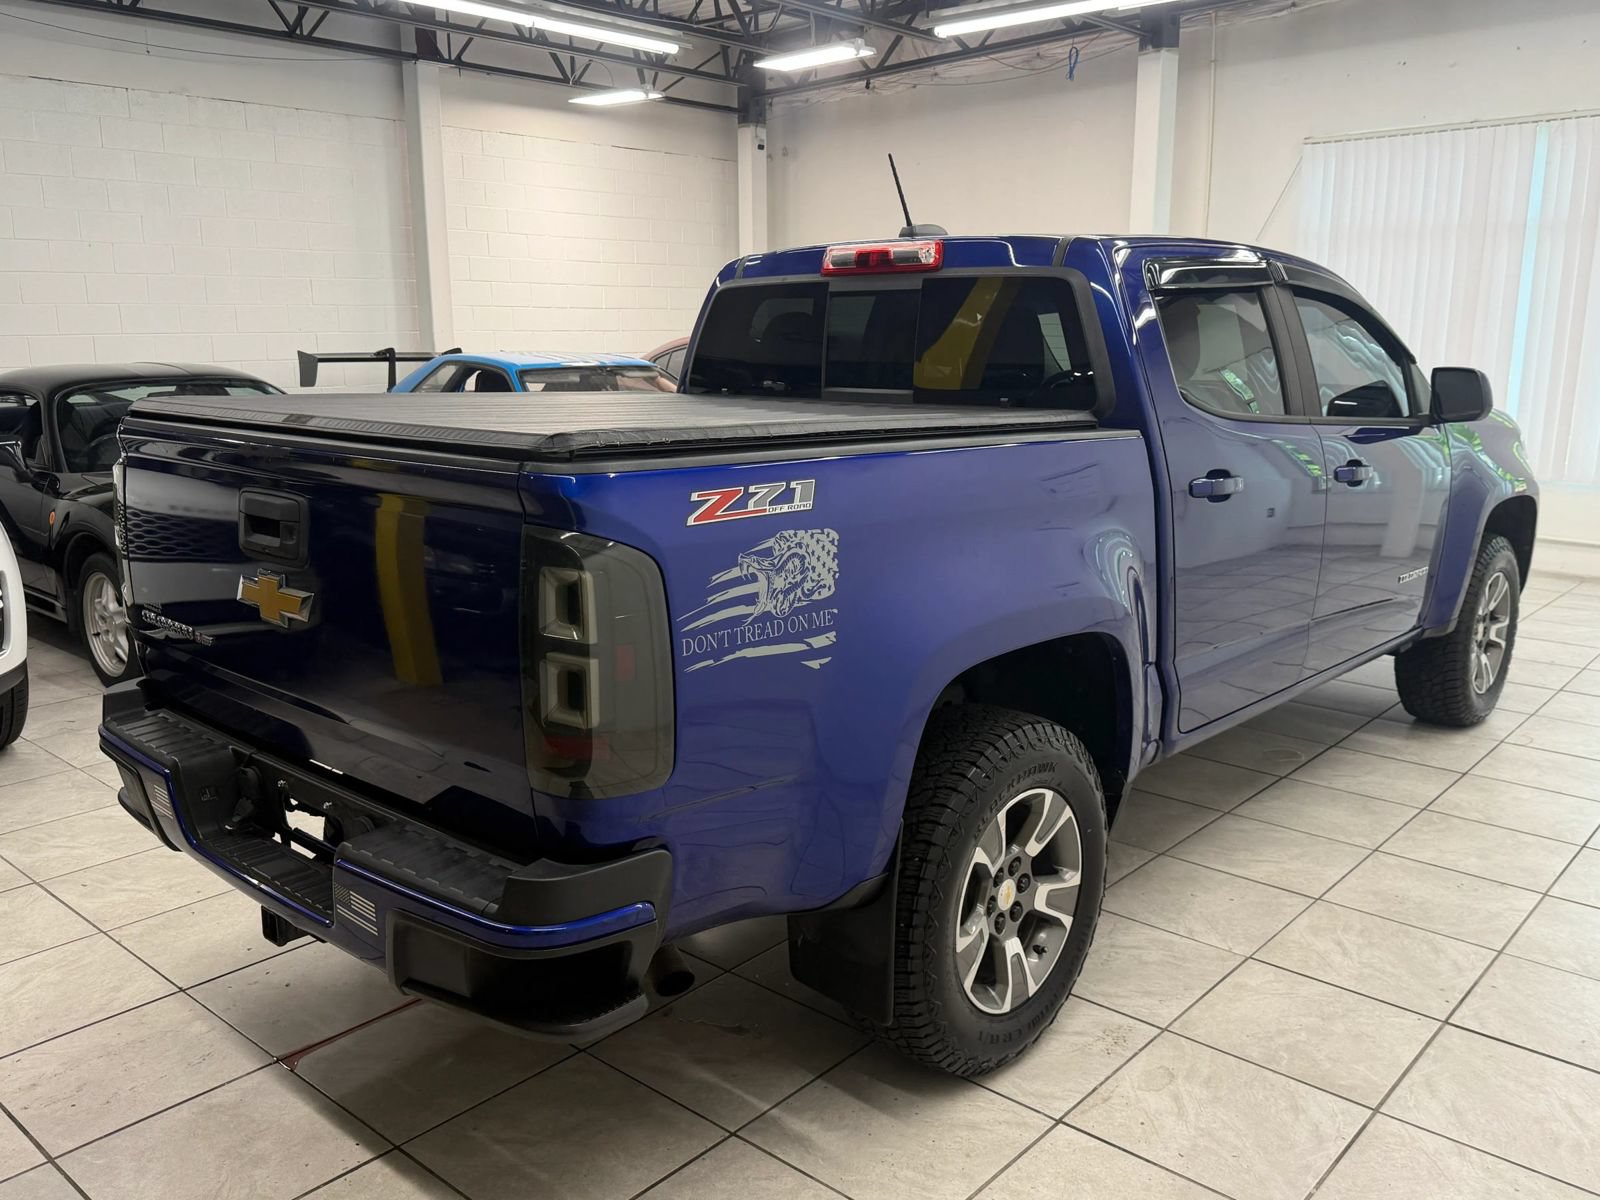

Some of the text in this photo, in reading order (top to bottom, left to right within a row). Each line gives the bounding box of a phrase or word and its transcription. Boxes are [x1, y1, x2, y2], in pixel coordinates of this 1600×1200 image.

[686, 479, 816, 526] Z71
[787, 502, 812, 511] ROAD
[682, 609, 834, 656] DON'T TREAD ON ME
